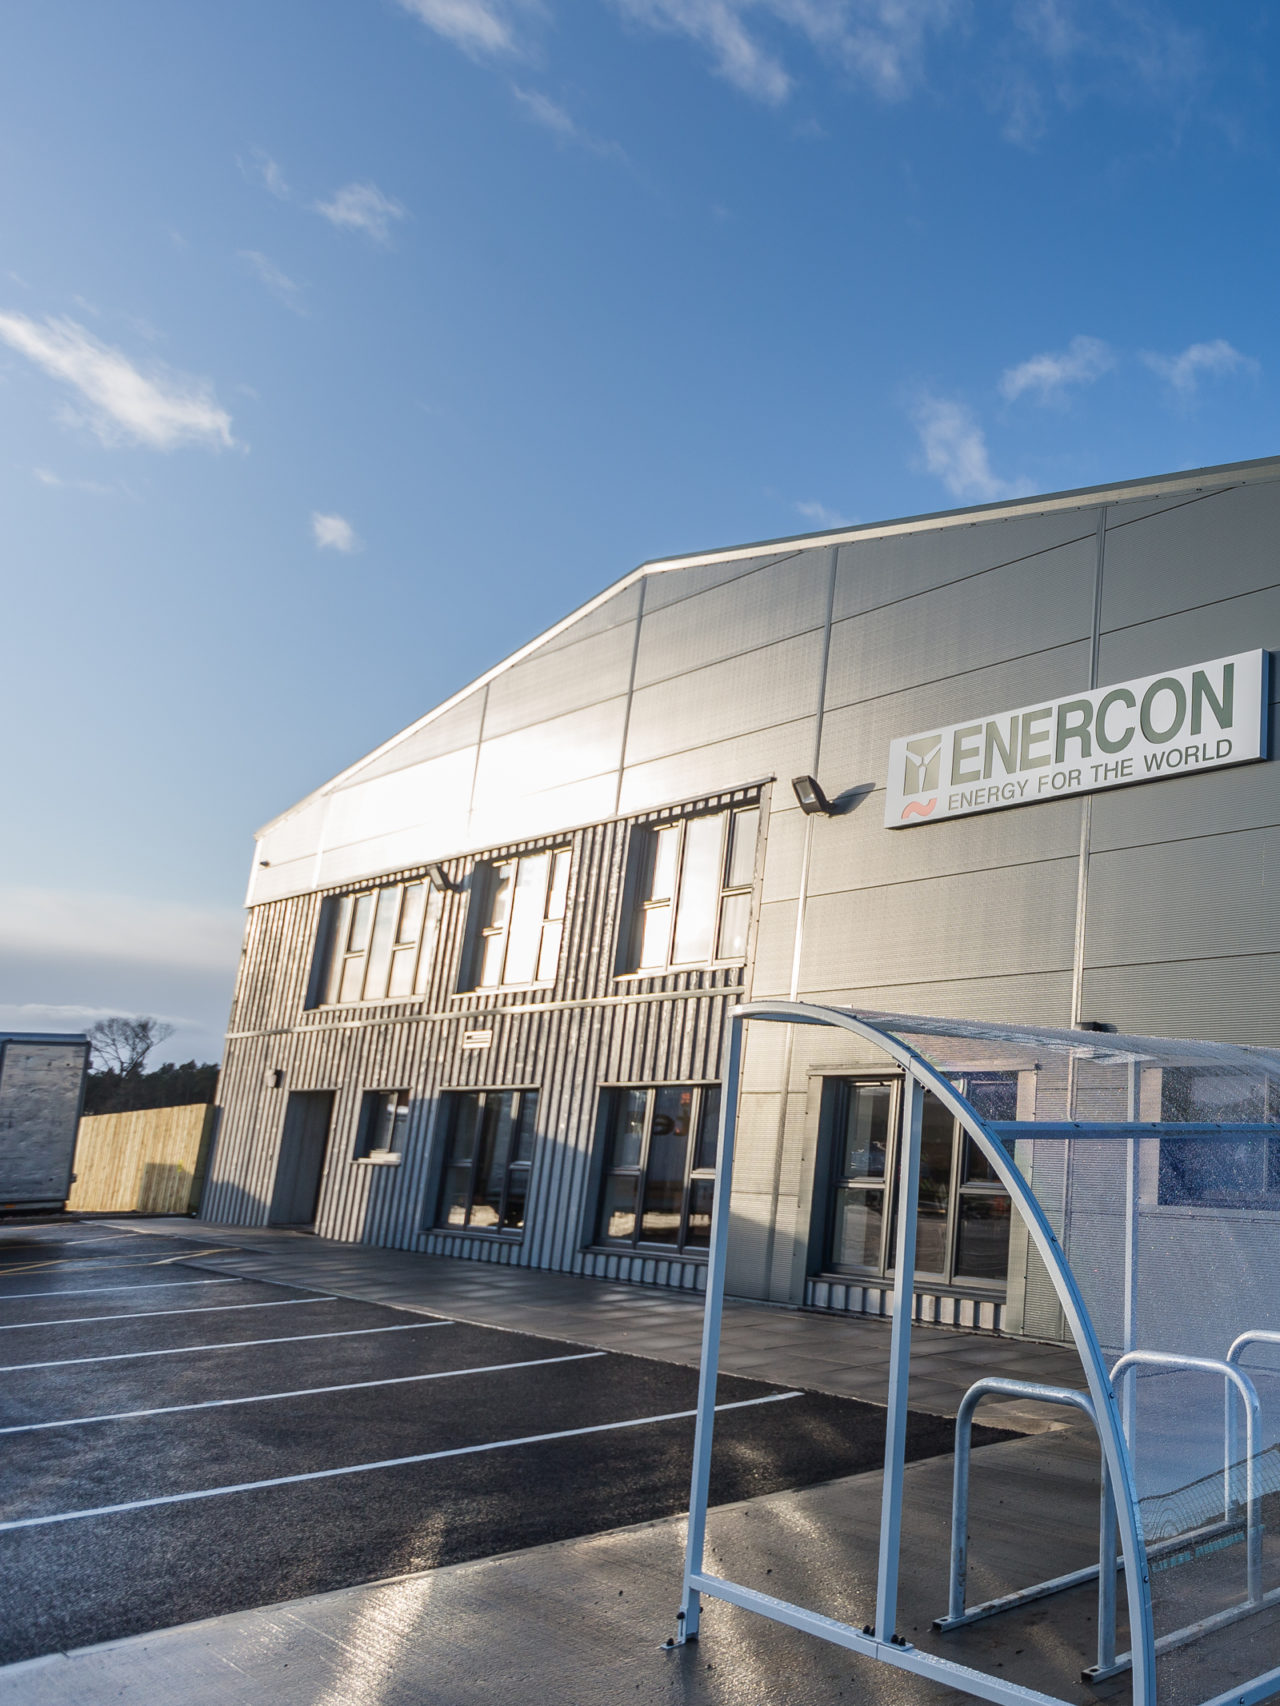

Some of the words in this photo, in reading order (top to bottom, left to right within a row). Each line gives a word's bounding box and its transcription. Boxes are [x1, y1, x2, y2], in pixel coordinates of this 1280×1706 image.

[951, 663, 1235, 786] ENERCON
[948, 779, 1032, 811] ENERGY
[1037, 768, 1082, 793] FOR
[1090, 758, 1134, 782] THE
[1144, 739, 1233, 772] WORLD
